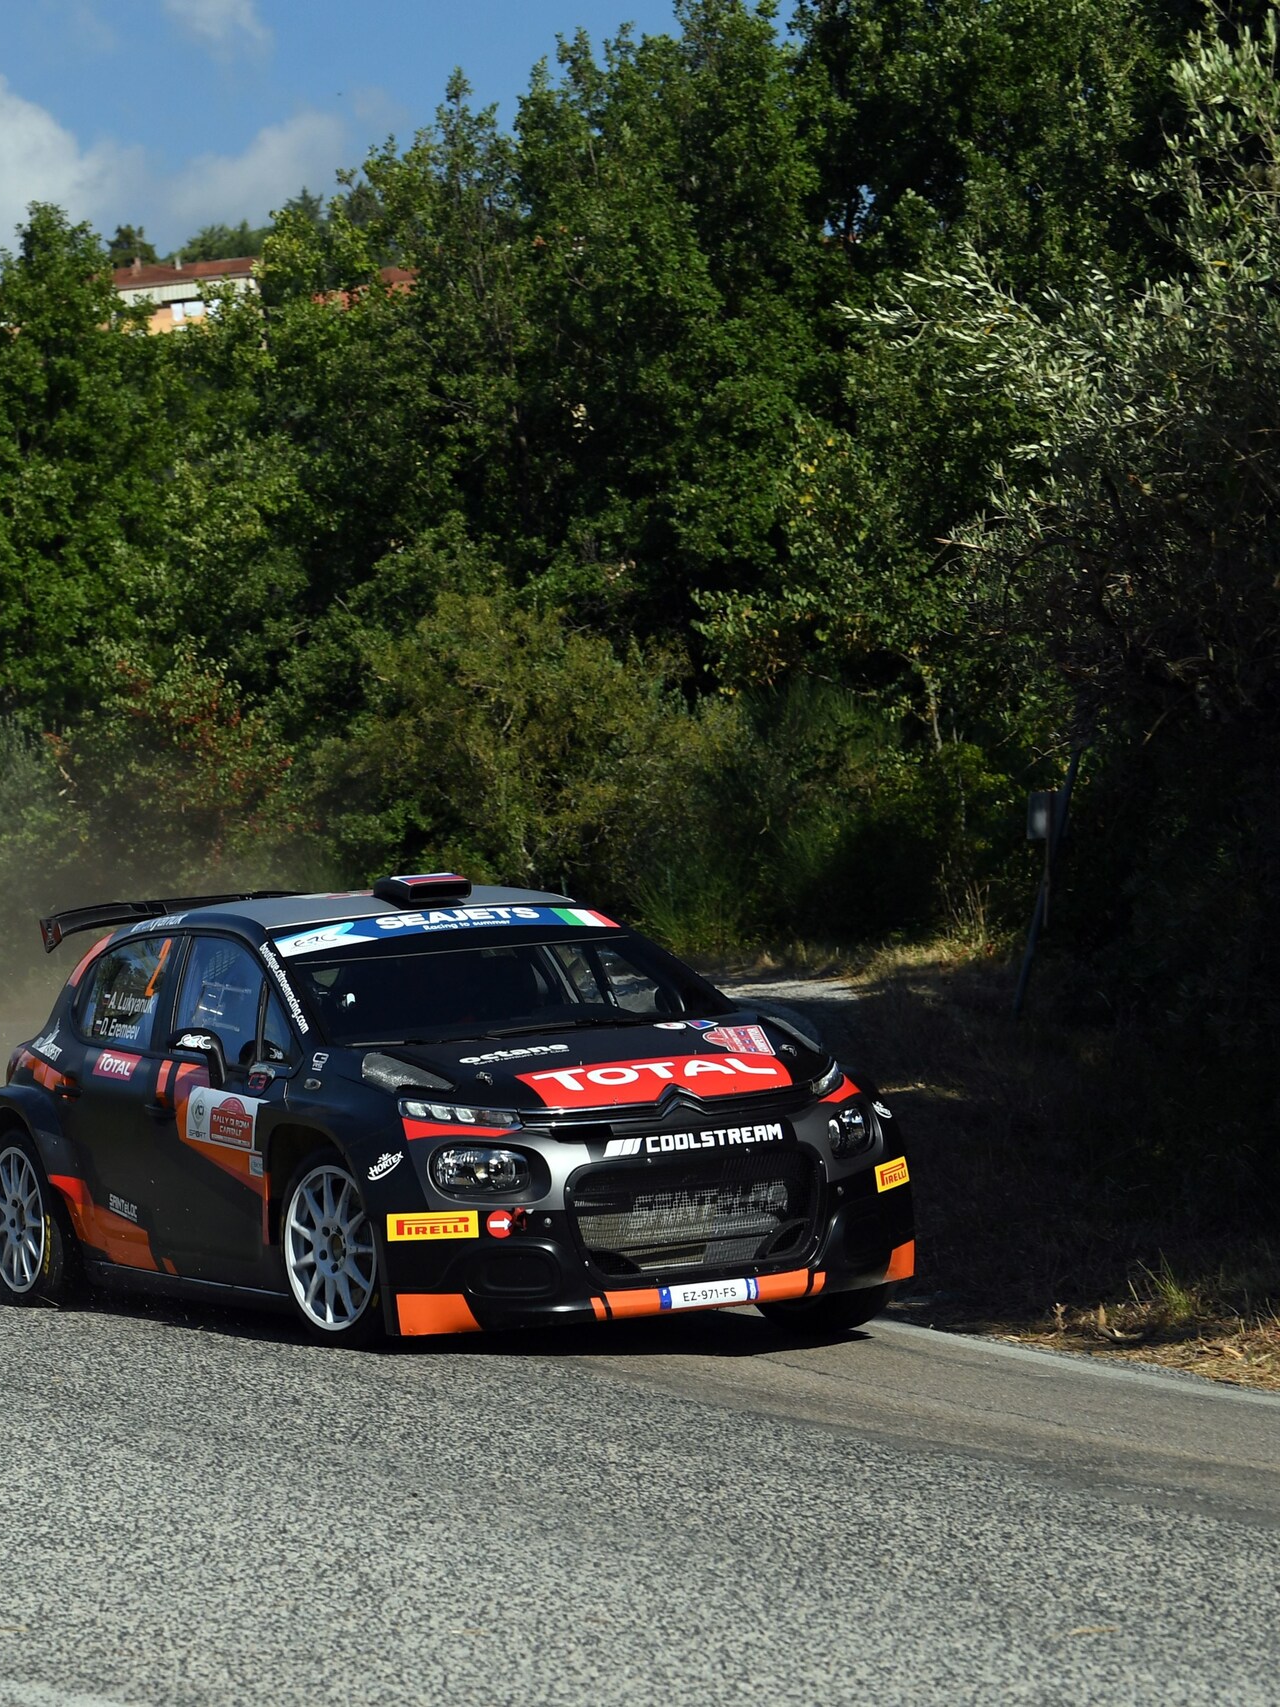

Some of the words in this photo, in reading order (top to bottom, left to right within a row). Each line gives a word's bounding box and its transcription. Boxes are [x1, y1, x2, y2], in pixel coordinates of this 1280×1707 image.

[376, 907, 540, 930] SEAJETS
[423, 922, 458, 931] Racing
[472, 919, 511, 927] summer
[259, 941, 309, 1034] boutique.citroenracing.com
[117, 992, 154, 1016] Lukyanuk
[100, 1017, 109, 1035] D.
[108, 1018, 140, 1040] Eremeev
[99, 1053, 131, 1076] TOTAL
[459, 1044, 569, 1064] octane
[532, 1057, 777, 1091] TOTAL
[212, 1113, 229, 1125] RALLY
[189, 1129, 207, 1138] SPORT
[645, 1123, 783, 1153] COOLSTREAM
[368, 1151, 404, 1177] HORTEX
[880, 1162, 907, 1187] PIRELLI
[396, 1217, 470, 1236] PIRELLI
[683, 1287, 737, 1302] EZ-971-FS
